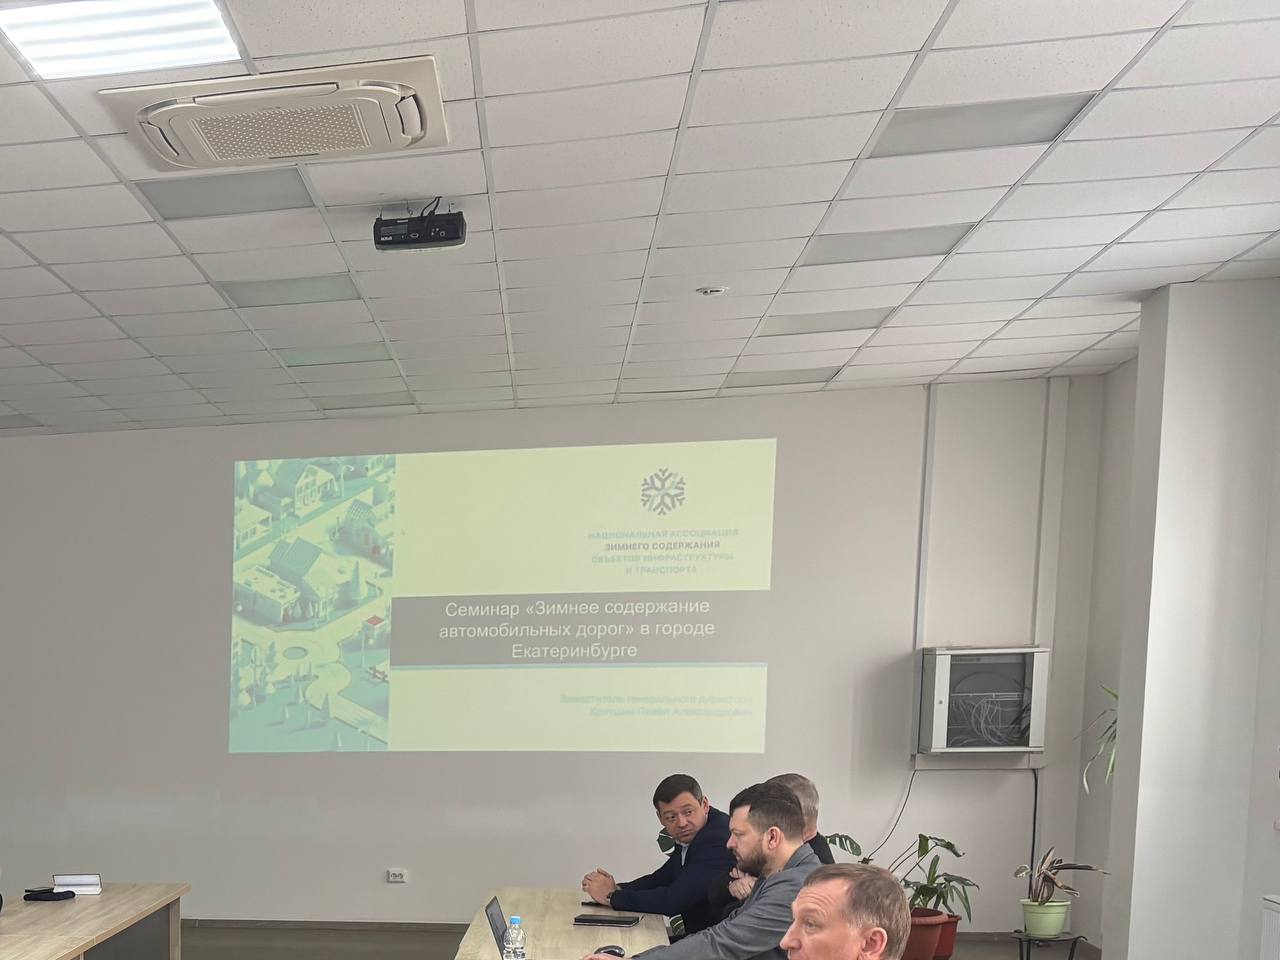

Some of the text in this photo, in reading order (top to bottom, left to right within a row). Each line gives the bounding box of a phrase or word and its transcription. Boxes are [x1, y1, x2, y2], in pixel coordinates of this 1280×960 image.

[604, 540, 720, 551] ЗИМНЕГО СОДЕРЖАНИЯ
[445, 600, 710, 618] Семинар «Зимнее содержание
[439, 622, 715, 639] автомобильных дорог» в городе
[511, 643, 638, 661] Екатеринбурге
